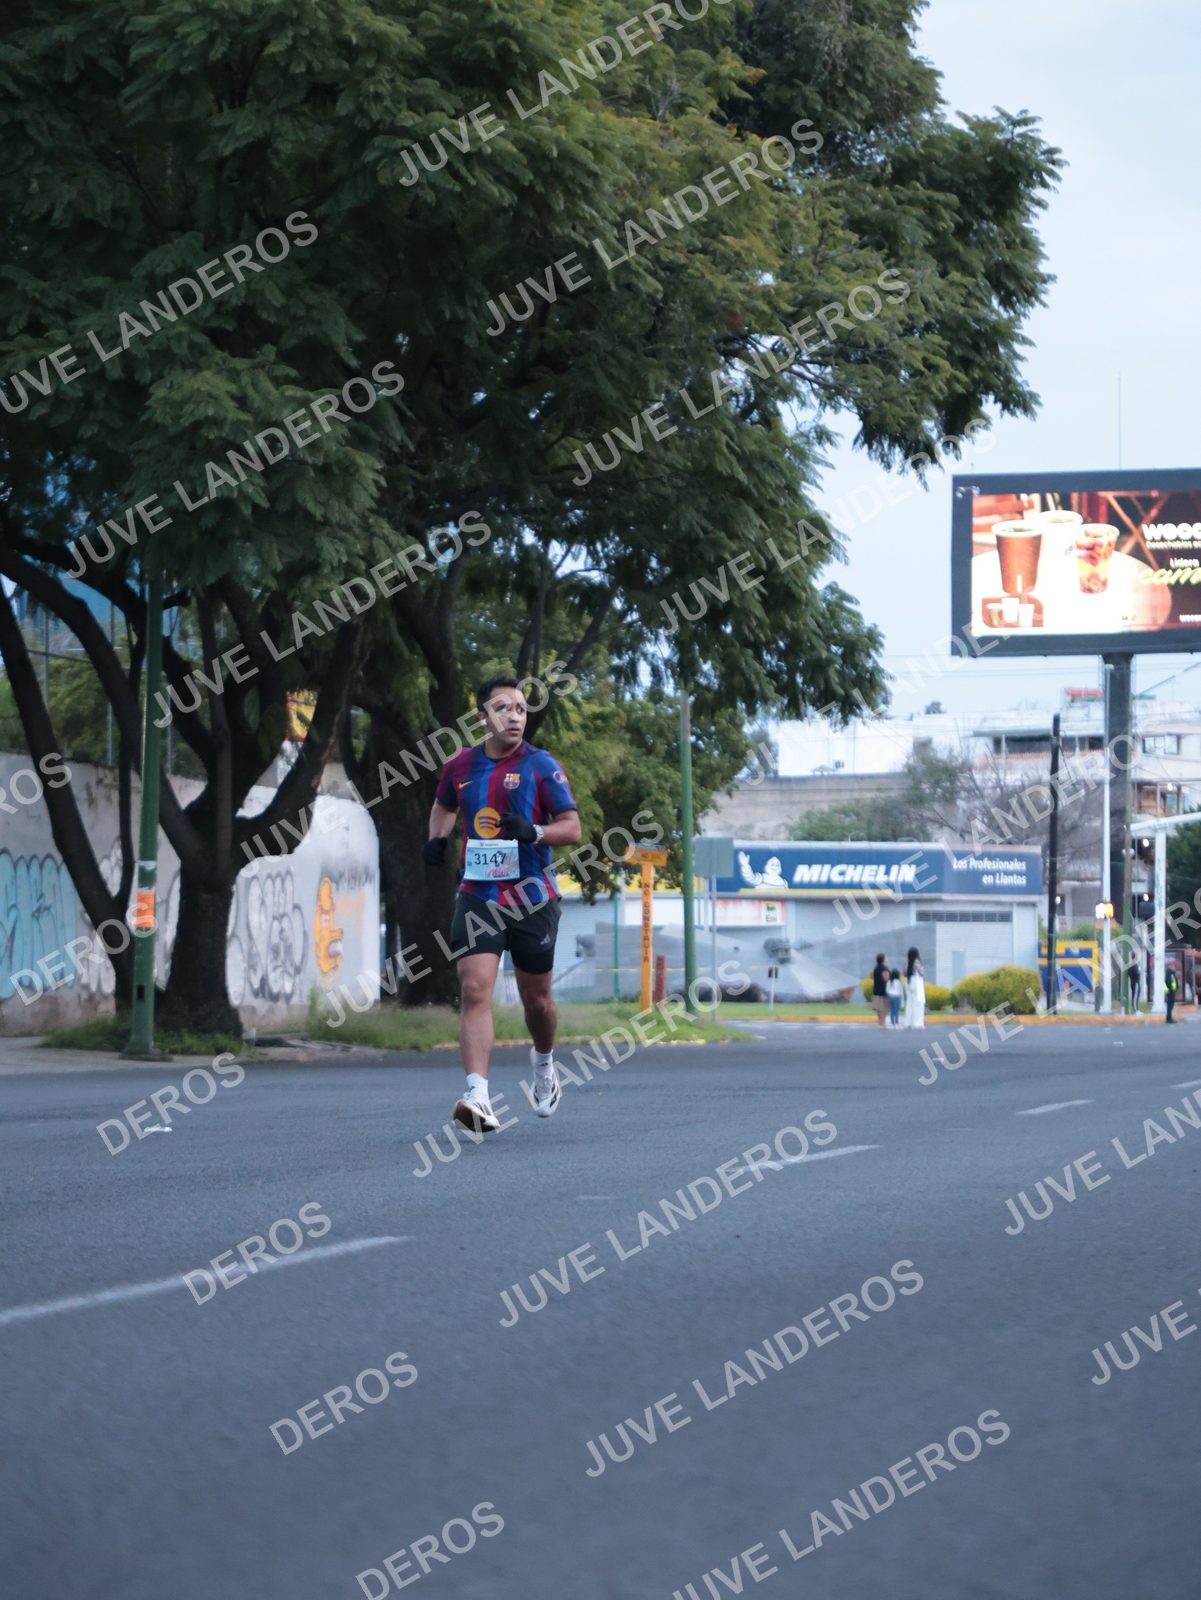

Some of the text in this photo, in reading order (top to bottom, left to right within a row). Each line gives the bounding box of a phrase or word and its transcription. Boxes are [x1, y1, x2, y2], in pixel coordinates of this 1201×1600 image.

[474, 852, 507, 866] 3147
[952, 857, 1027, 871] Los Profesionales
[792, 864, 916, 883] MICHELIN
[982, 873, 1027, 885] en Llantas
